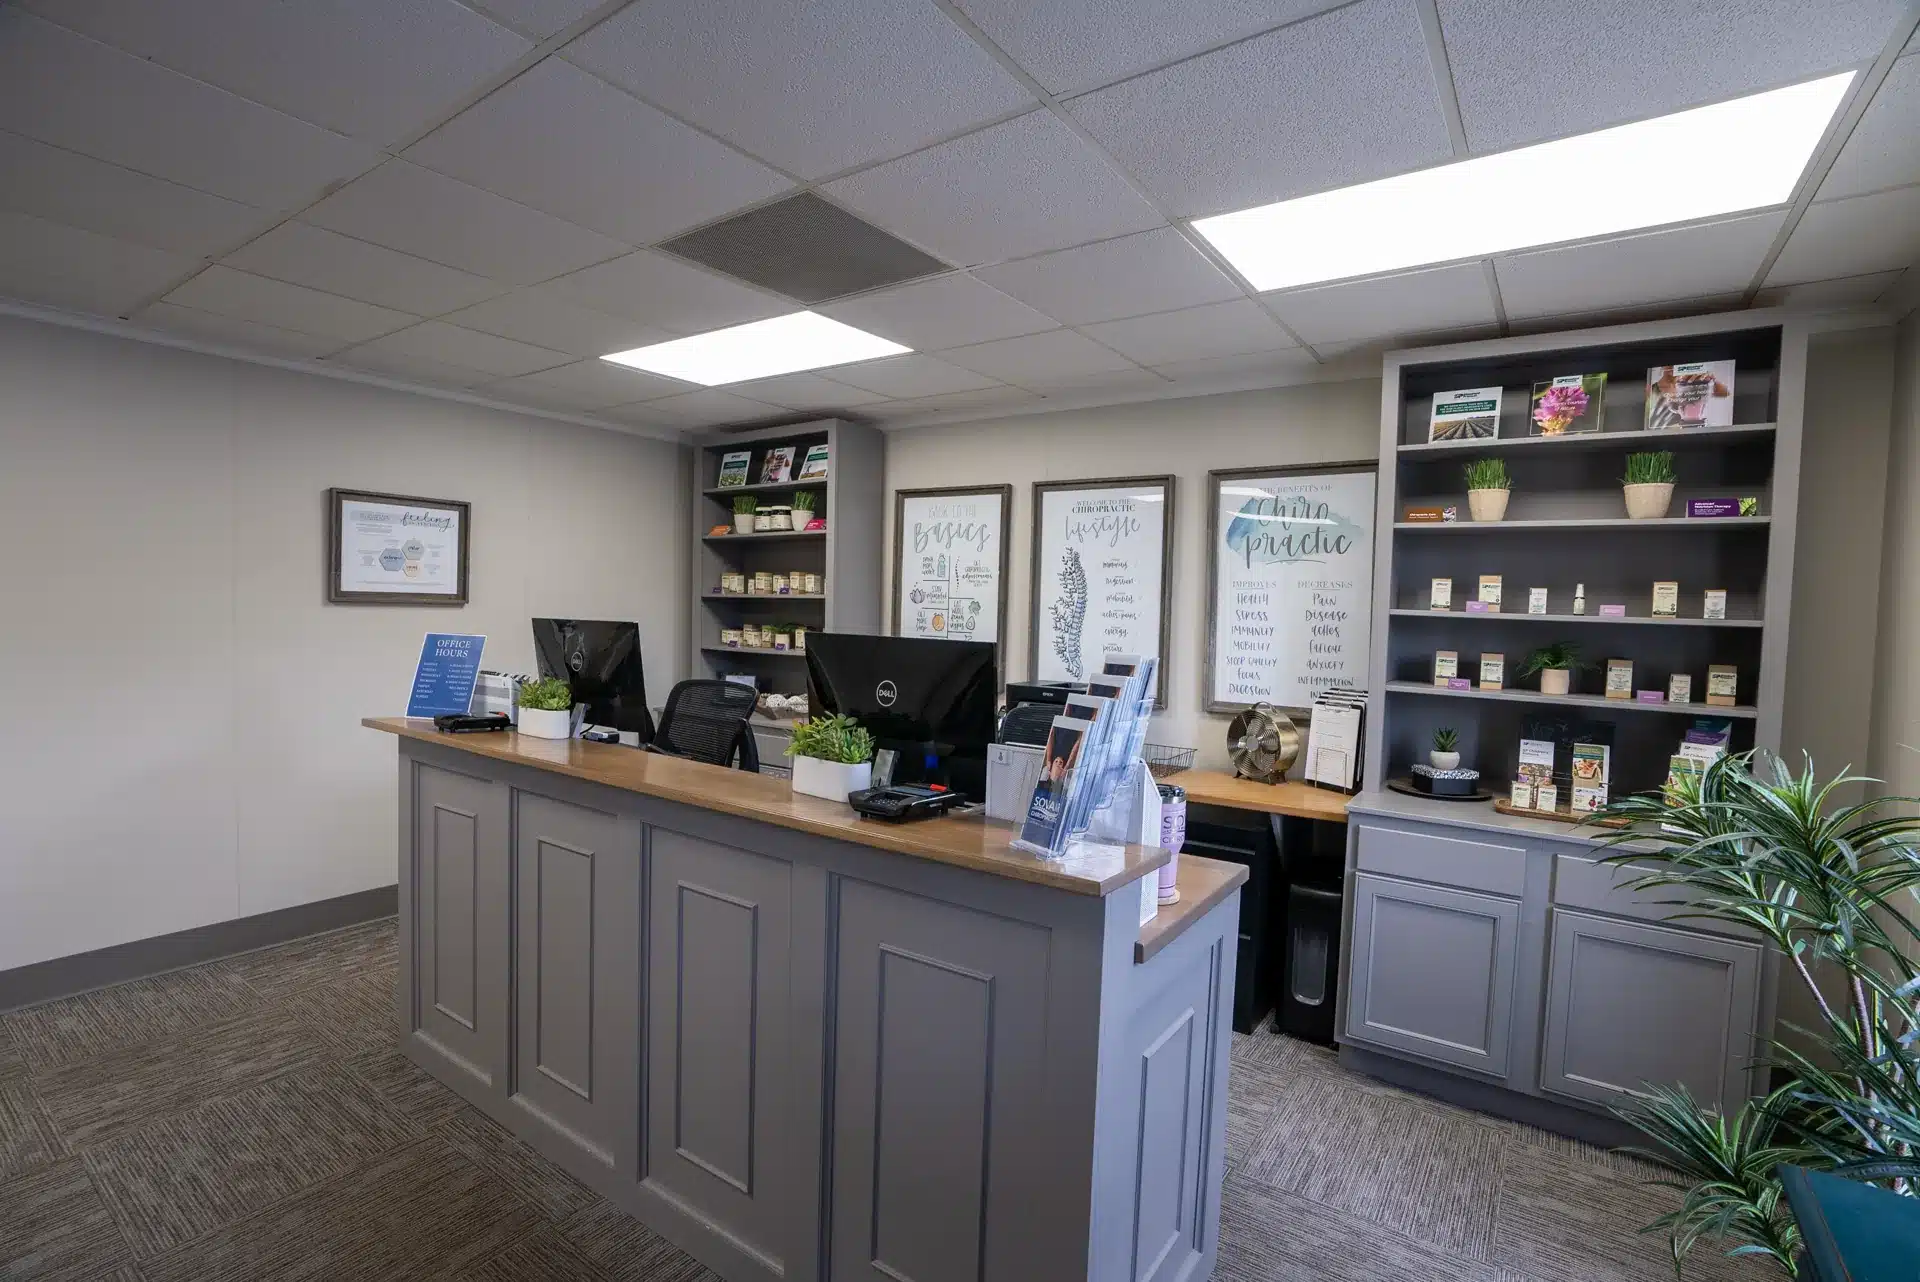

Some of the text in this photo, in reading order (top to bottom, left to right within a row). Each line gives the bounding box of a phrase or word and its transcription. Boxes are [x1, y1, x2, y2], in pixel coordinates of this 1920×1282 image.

[1277, 484, 1319, 494] BENEFITS
[1072, 504, 1136, 514] CHIROPRACTIC
[913, 520, 991, 553] Basics
[1244, 525, 1353, 570] practic
[1232, 580, 1277, 589] IMPROVES
[1297, 580, 1353, 589] DECREASES
[436, 639, 473, 649] OFFICE
[435, 648, 469, 658] HOURS
[878, 689, 895, 698] DELL
